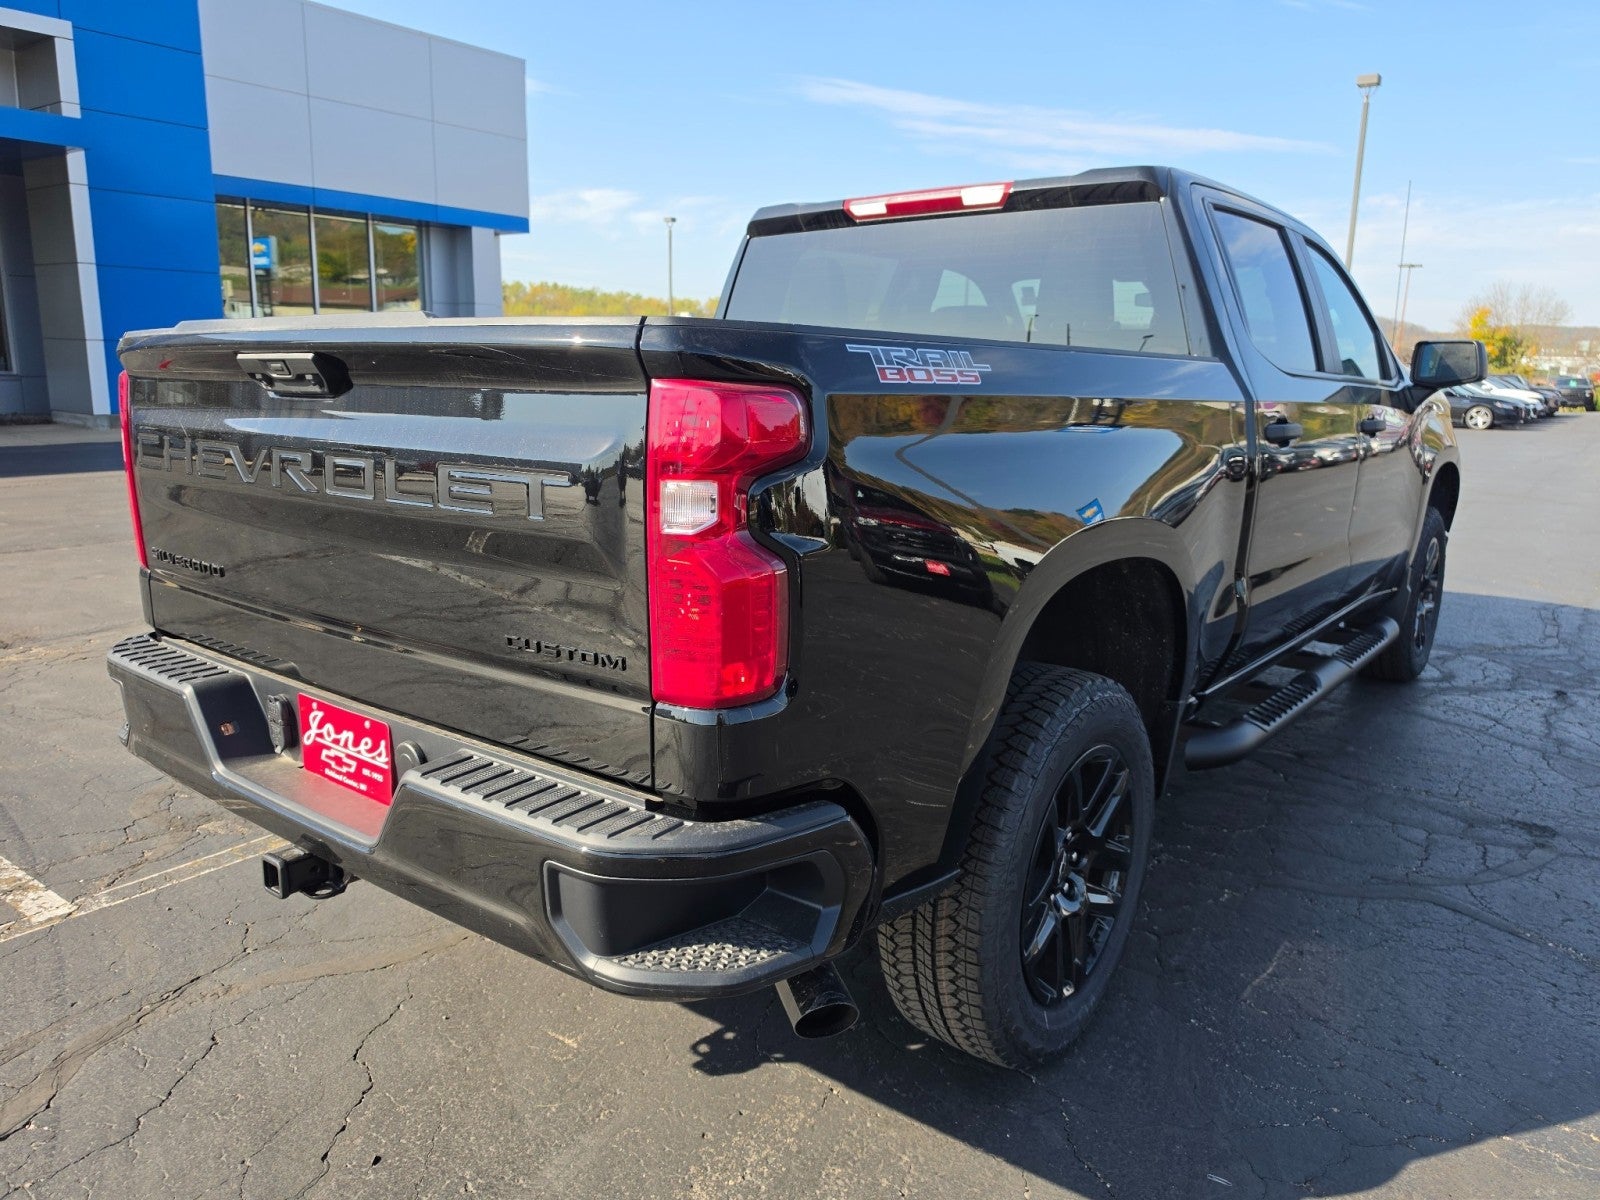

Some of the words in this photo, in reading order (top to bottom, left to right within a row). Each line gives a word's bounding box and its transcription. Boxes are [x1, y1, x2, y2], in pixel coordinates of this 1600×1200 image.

[845, 343, 992, 372] TRAIL
[875, 365, 982, 385] BOSS
[137, 433, 573, 521] CHEVROLET
[151, 546, 226, 578] SILVERADO
[504, 634, 628, 672] CUSTOM
[303, 710, 389, 763] Jones
